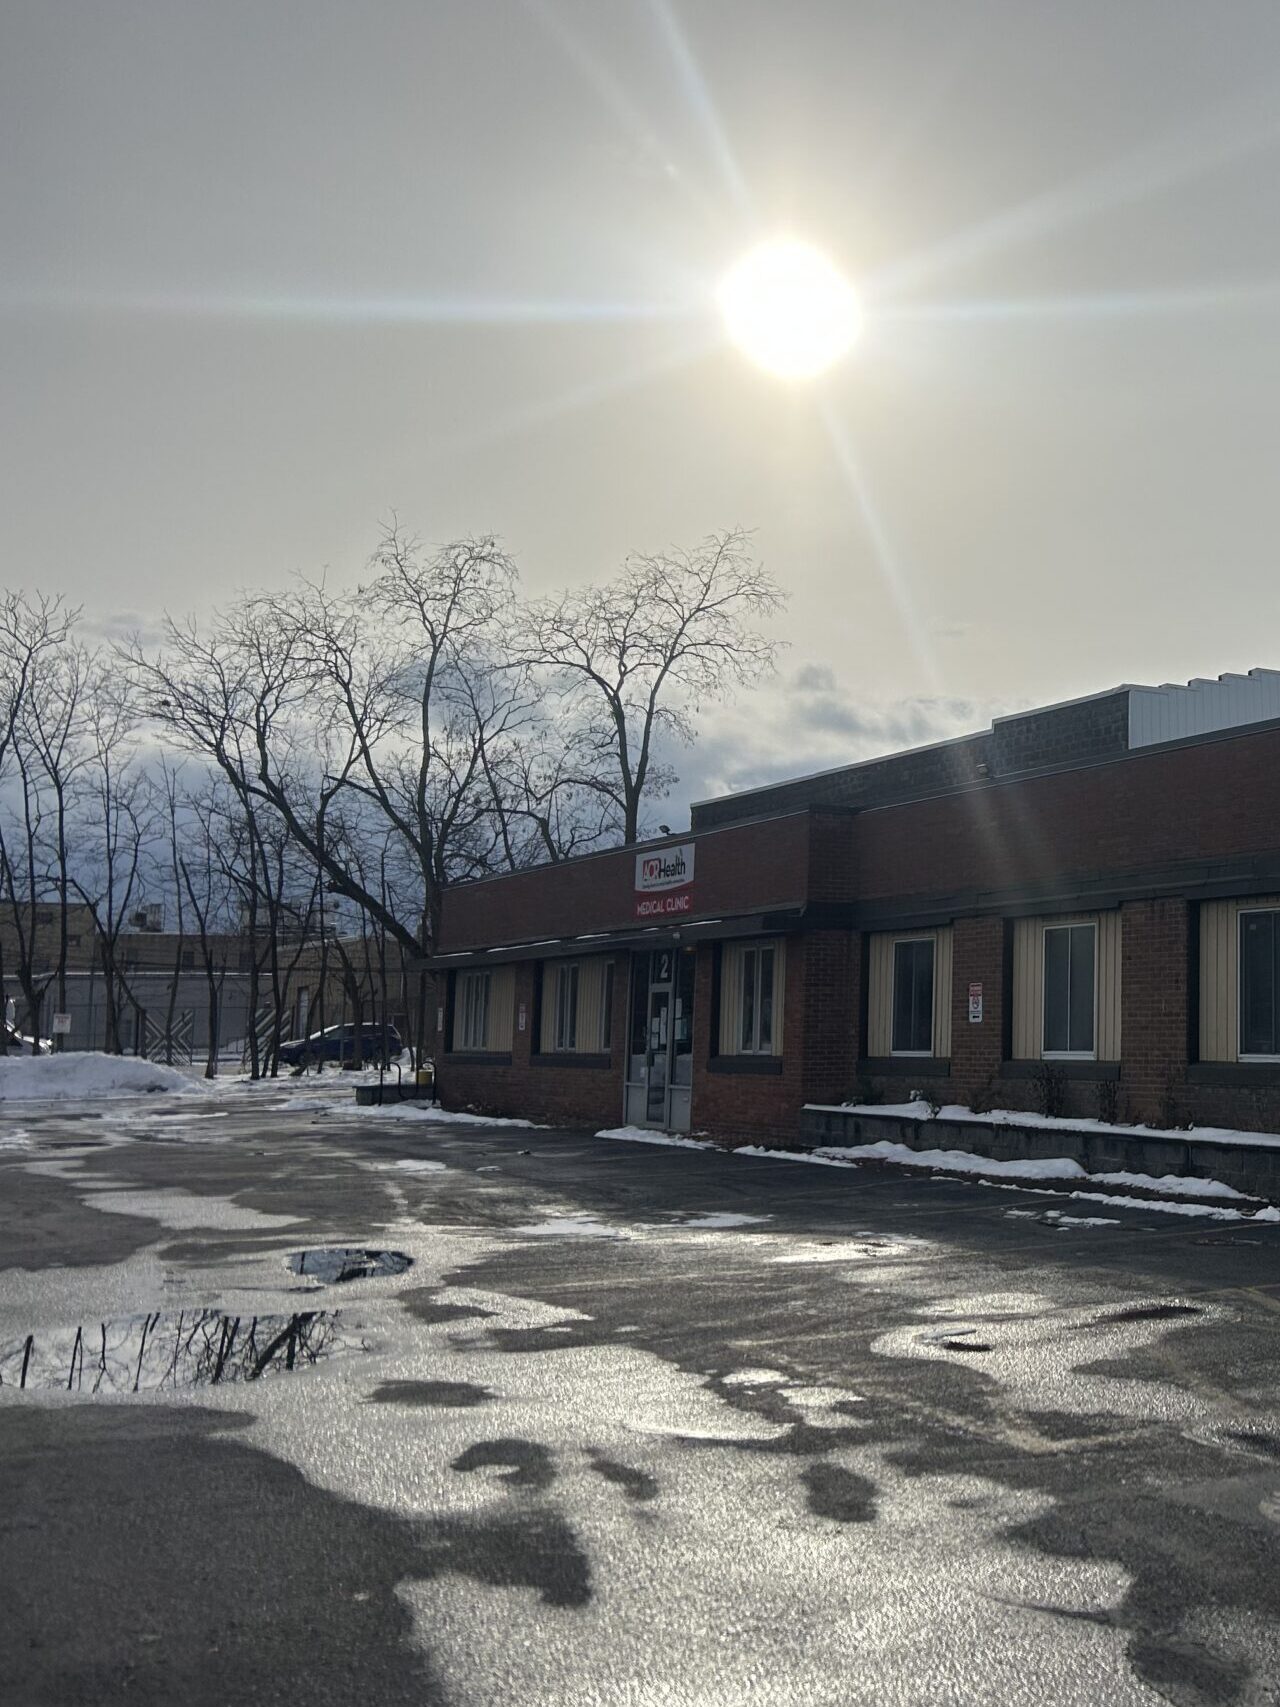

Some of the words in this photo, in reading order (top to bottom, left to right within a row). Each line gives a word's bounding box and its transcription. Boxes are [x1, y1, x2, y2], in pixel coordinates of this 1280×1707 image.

[637, 900, 665, 916] MEDICAL
[666, 895, 689, 911] CLINIC
[660, 954, 669, 979] 2
